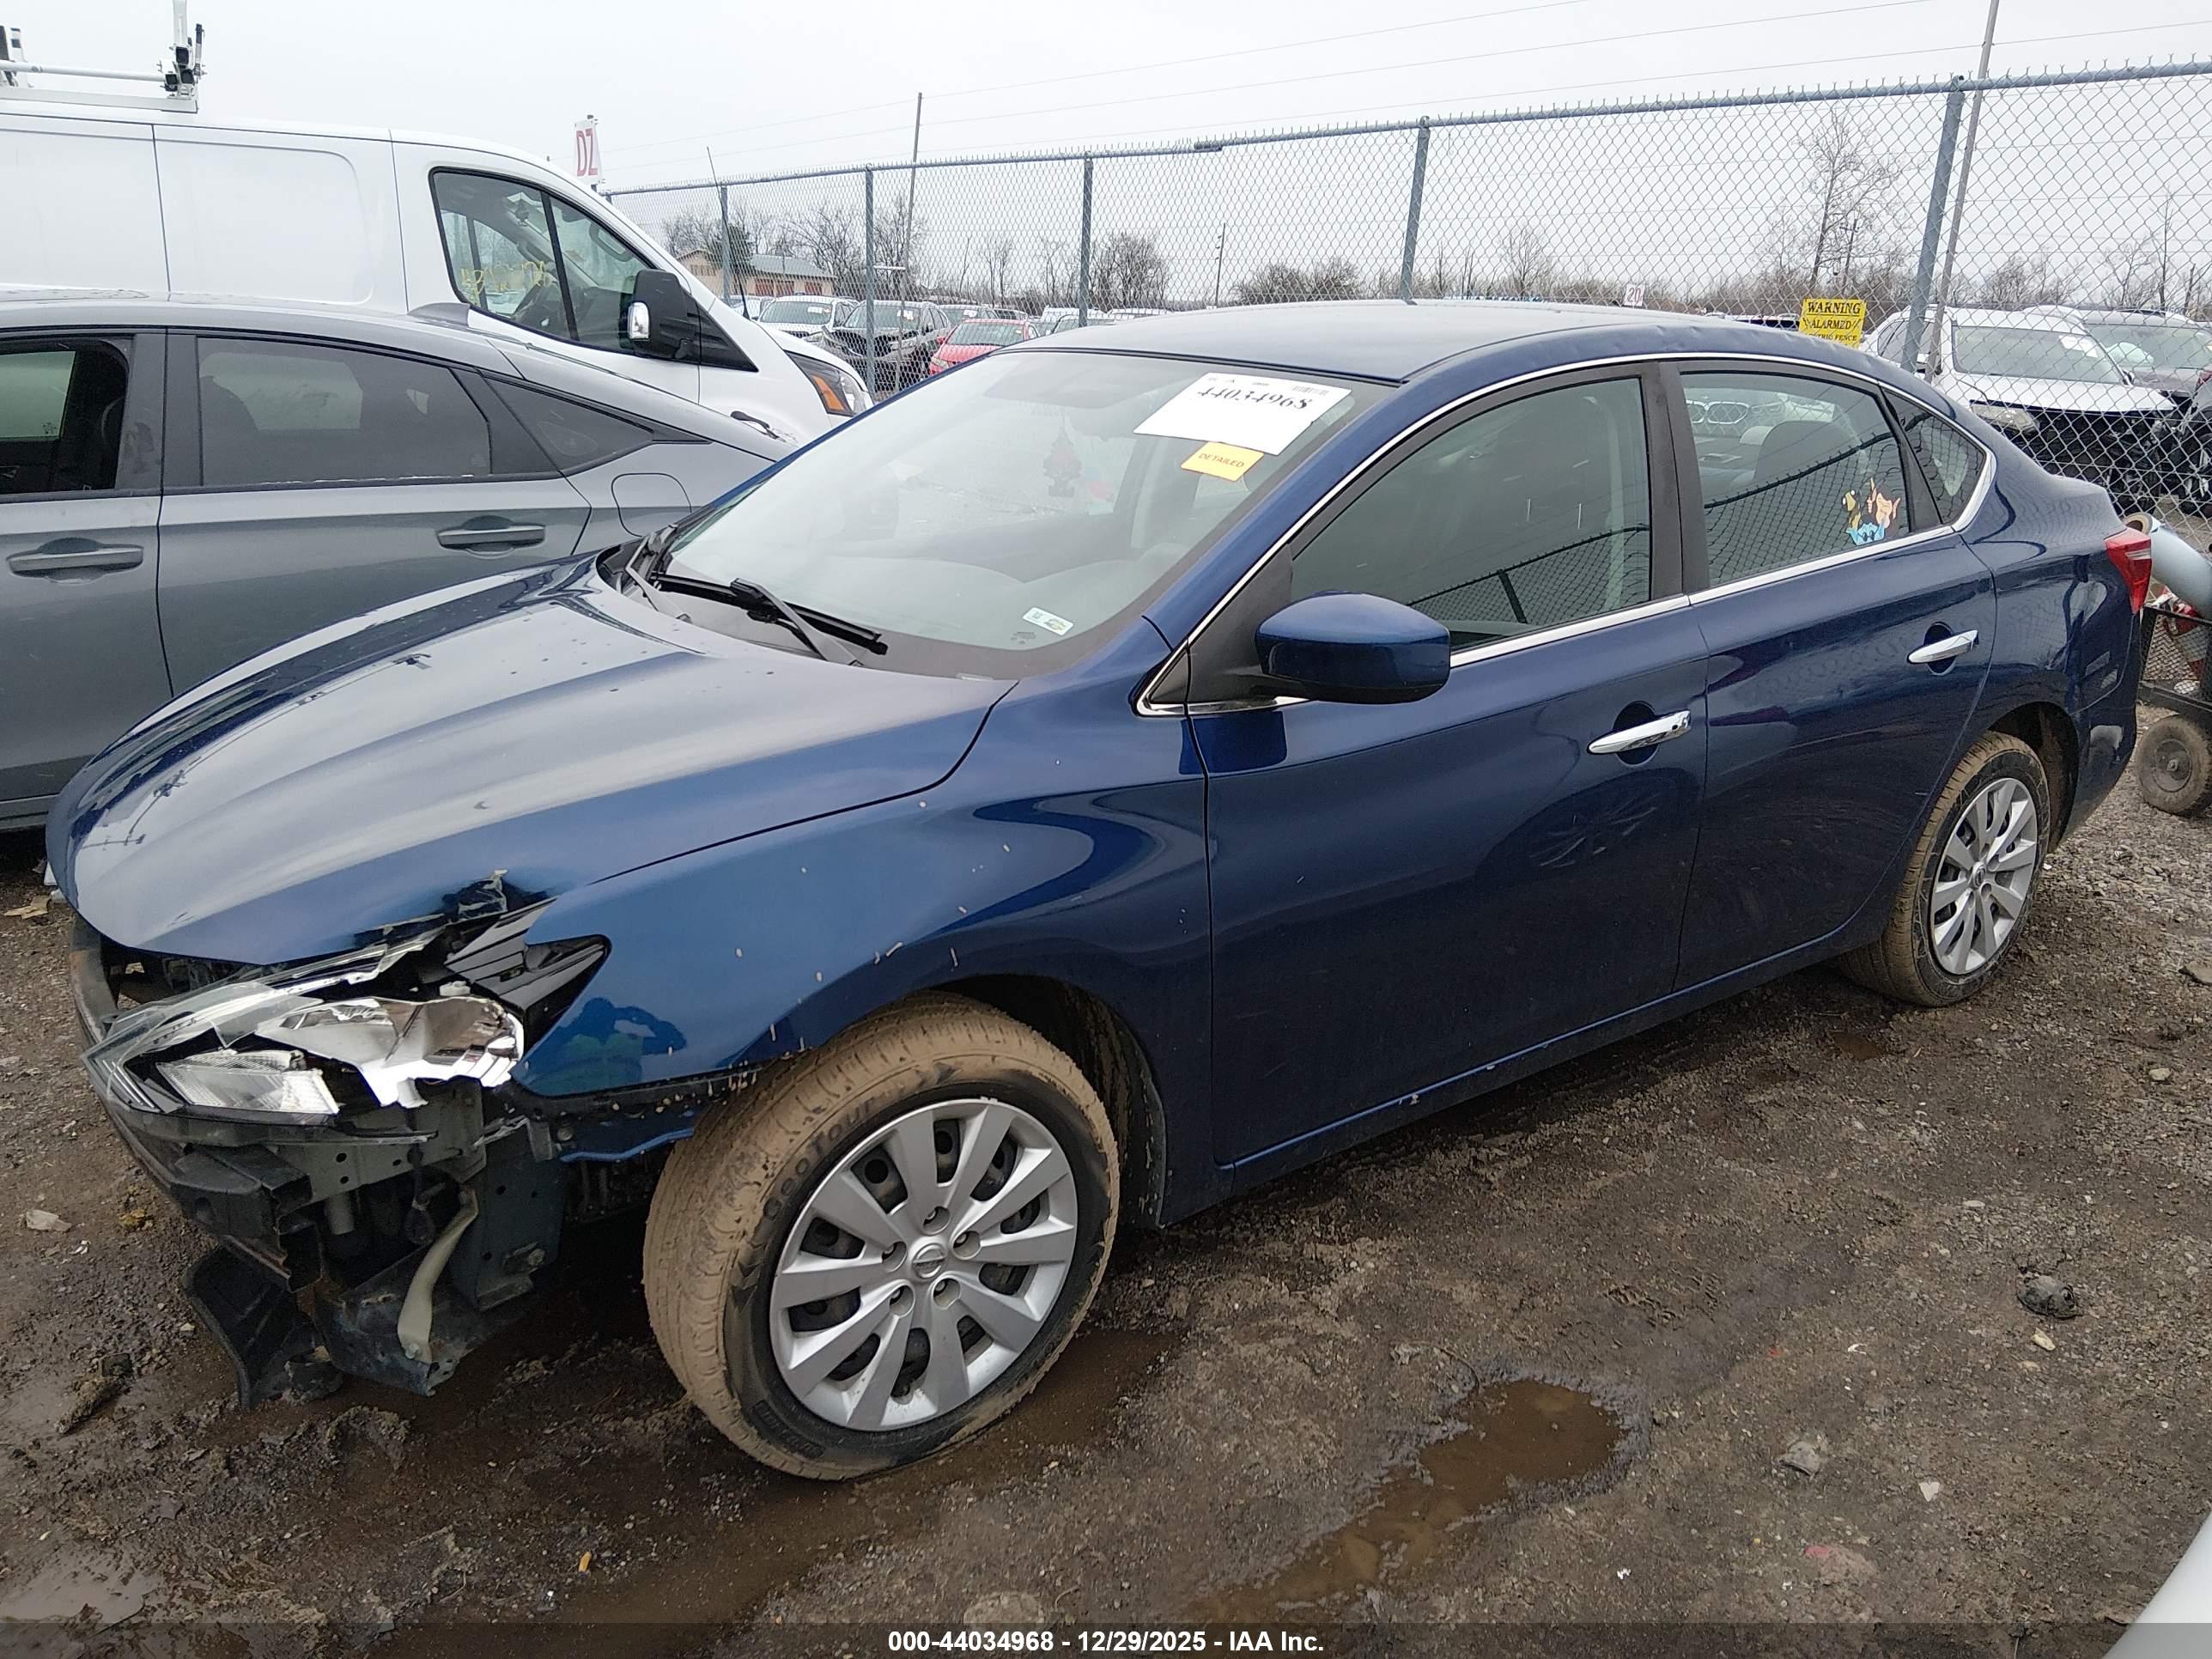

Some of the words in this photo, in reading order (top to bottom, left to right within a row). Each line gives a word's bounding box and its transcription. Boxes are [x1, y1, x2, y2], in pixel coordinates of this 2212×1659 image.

[1808, 301, 1861, 314] WARNING
[1198, 386, 1312, 410] 44034968
[1198, 453, 1245, 468] DETAILED
